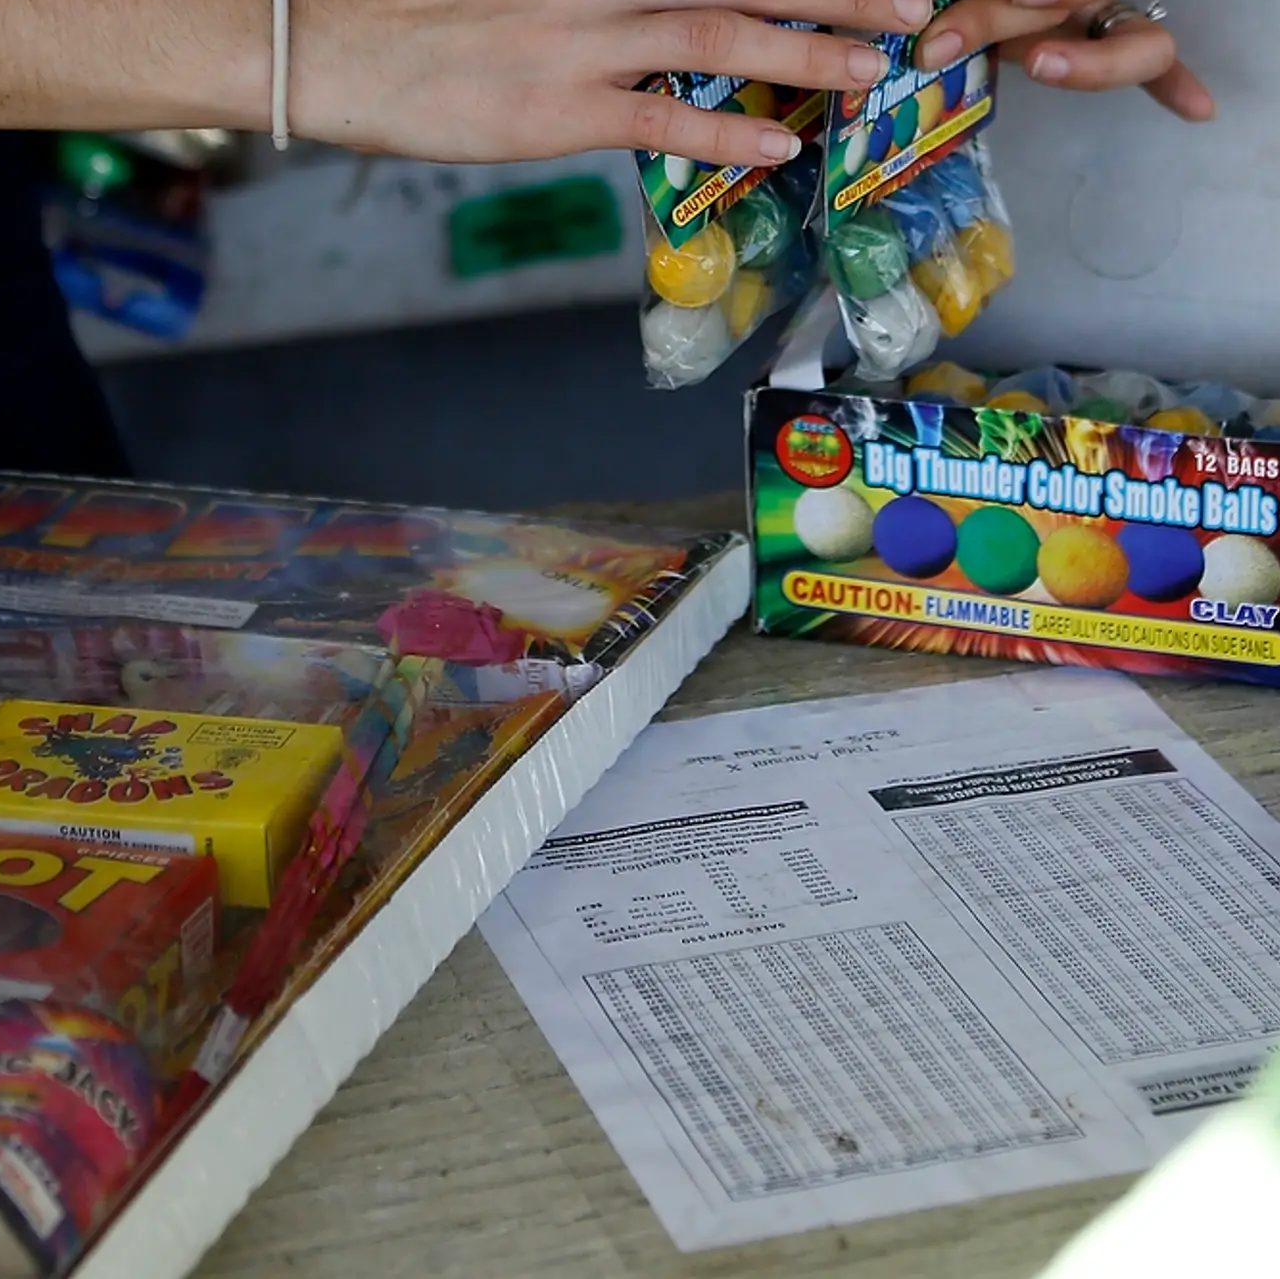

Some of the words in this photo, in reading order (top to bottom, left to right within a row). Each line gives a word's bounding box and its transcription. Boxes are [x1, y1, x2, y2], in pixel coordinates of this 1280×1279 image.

[1194, 453, 1217, 472] 12
[1227, 454, 1280, 478] BAGS
[866, 441, 913, 494] Big
[914, 446, 1026, 503] Thunder
[1027, 459, 1104, 516] Color
[1104, 469, 1201, 527] Smoke
[1202, 481, 1280, 536] Balls
[1190, 599, 1280, 628] CLAY
[925, 596, 1031, 630] FLAMMABLE
[1033, 612, 1099, 640] CAREFULLY
[1099, 621, 1131, 643] READ
[1132, 627, 1191, 651] CAUTIONS
[1192, 634, 1211, 652] ON
[1212, 636, 1239, 656] SIDE
[1239, 639, 1277, 661] PANEL
[18, 711, 178, 741] SNAP
[732, 745, 779, 760] Total
[830, 743, 879, 758] Total
[751, 750, 820, 769] Amount
[933, 783, 1008, 802] RYLANDER
[59, 825, 121, 840] CAUTION
[681, 851, 708, 865] Tax
[709, 845, 748, 861] Sales
[610, 854, 680, 875] Question?
[706, 927, 743, 941] OVER
[743, 922, 787, 937] SALES
[1148, 1091, 1200, 1106] Chart
